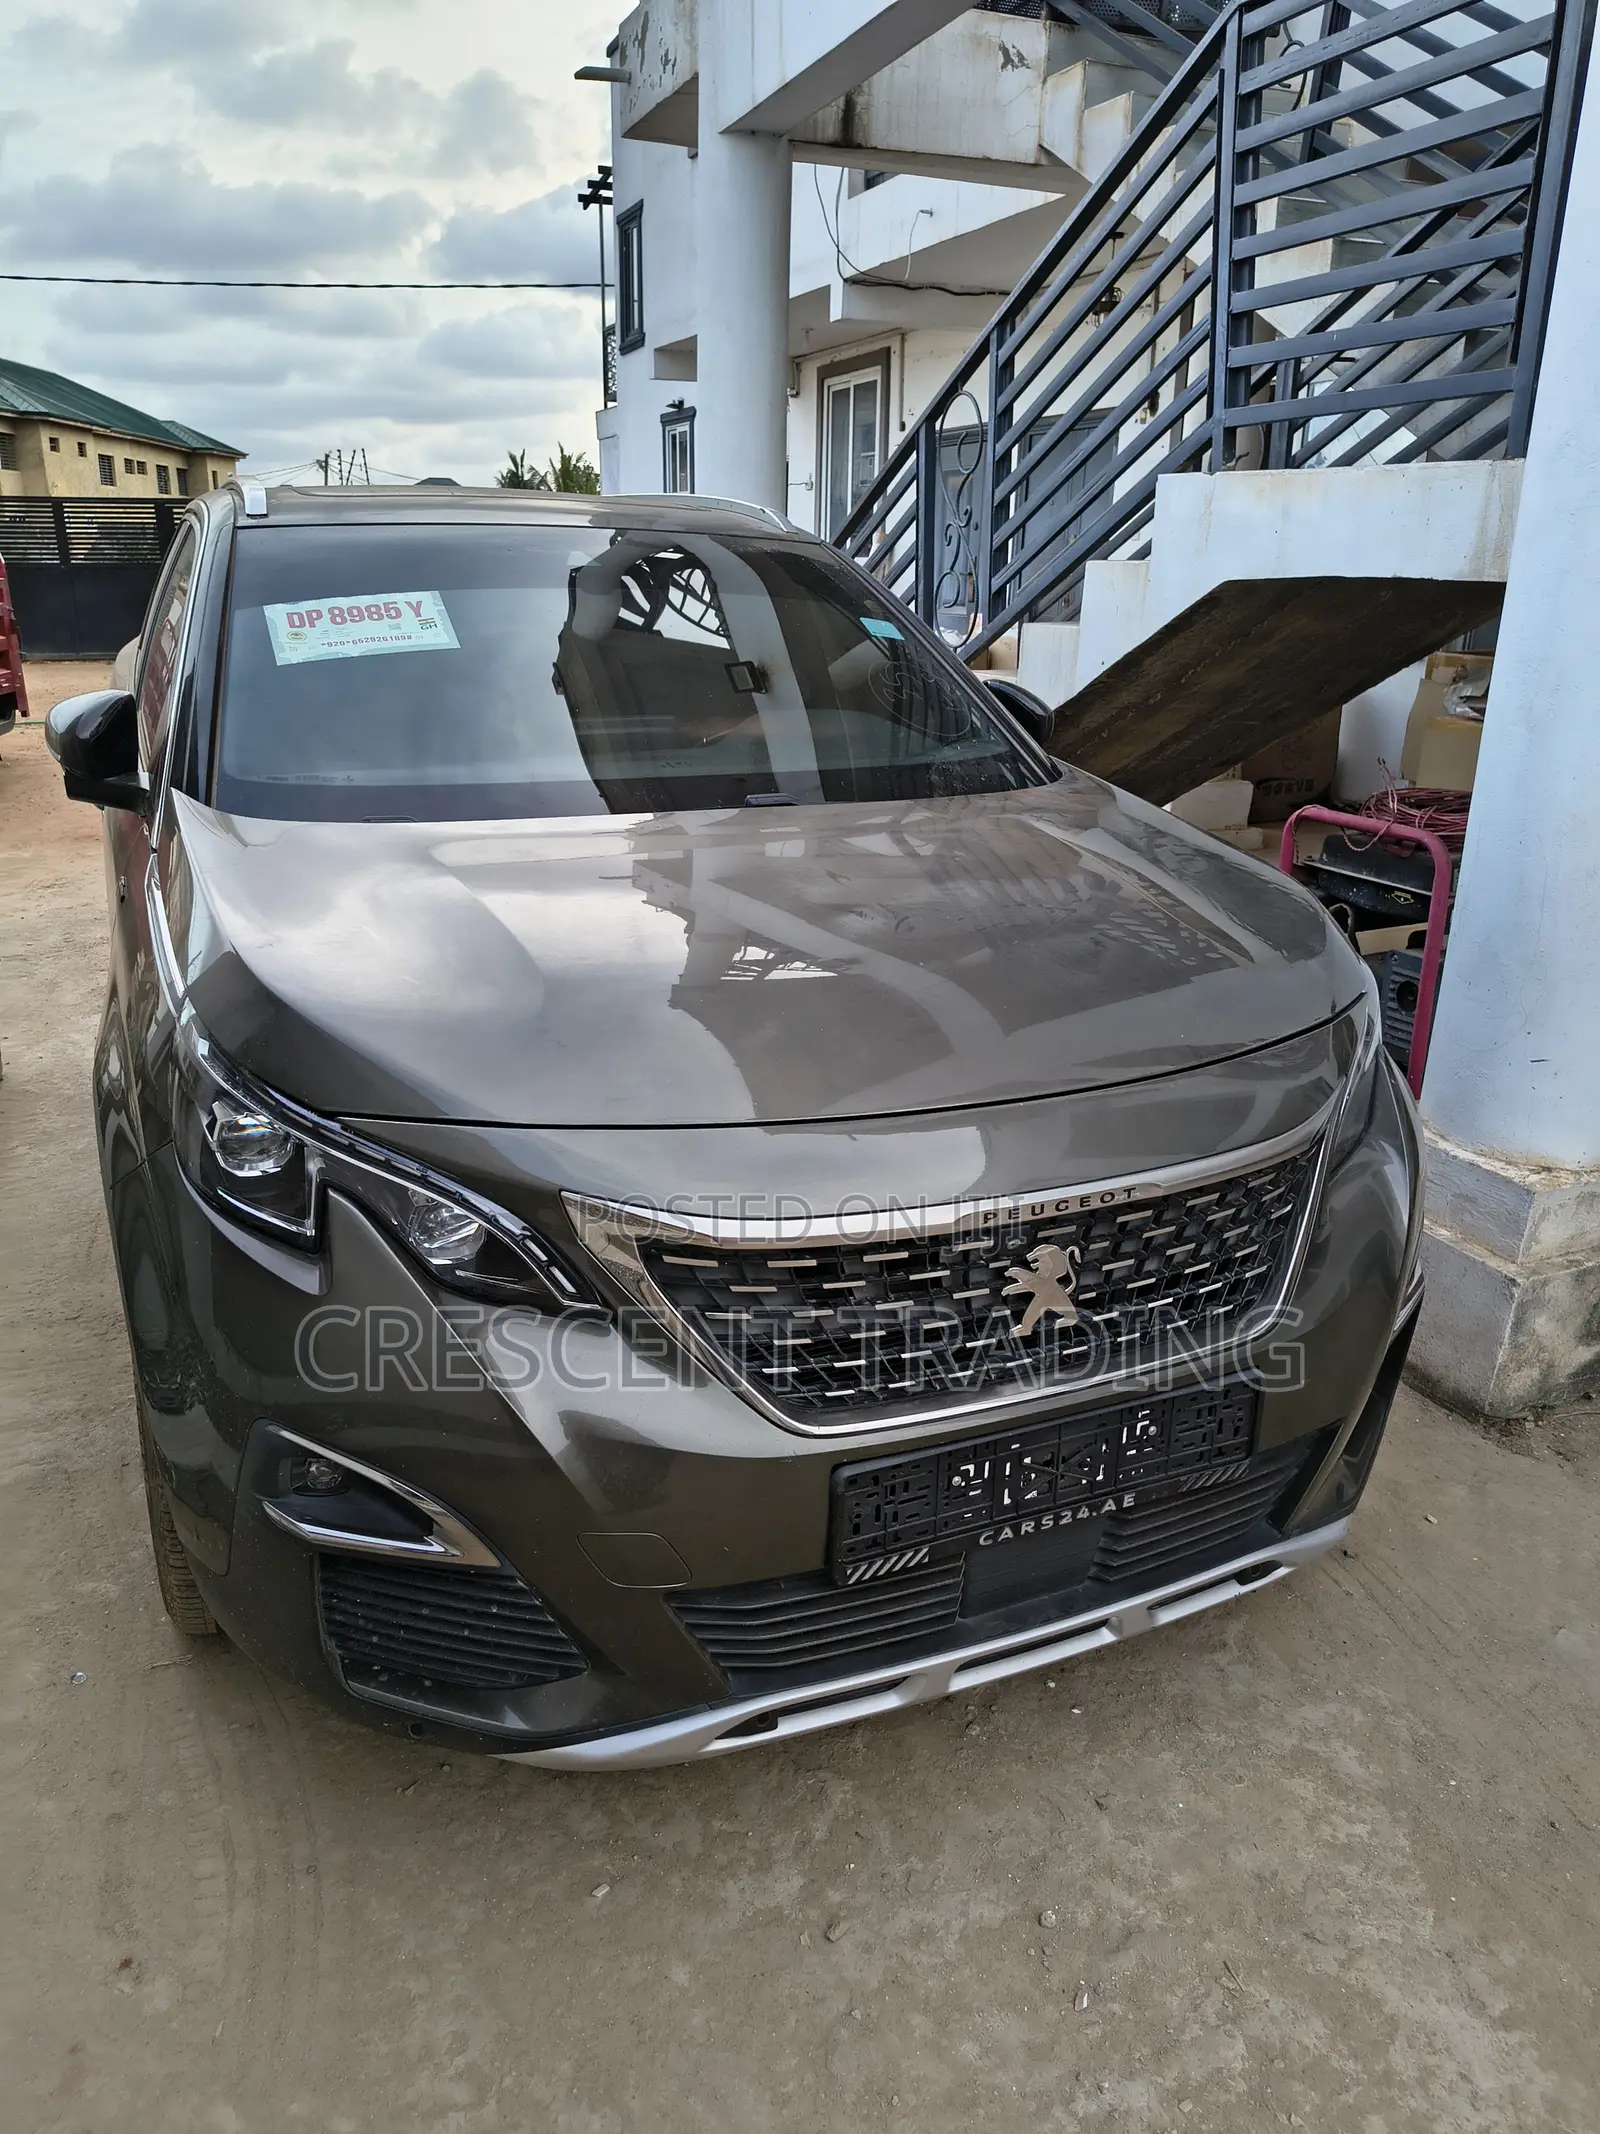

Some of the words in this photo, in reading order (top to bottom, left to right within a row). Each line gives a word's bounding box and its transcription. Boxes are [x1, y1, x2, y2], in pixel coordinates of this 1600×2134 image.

[286, 609, 323, 629] DP
[327, 602, 402, 626] 8985
[404, 600, 423, 618] Y
[420, 622, 438, 631] GH
[982, 1186, 1137, 1224] PEUGEOT
[978, 1492, 1136, 1546] CARS24.AE
